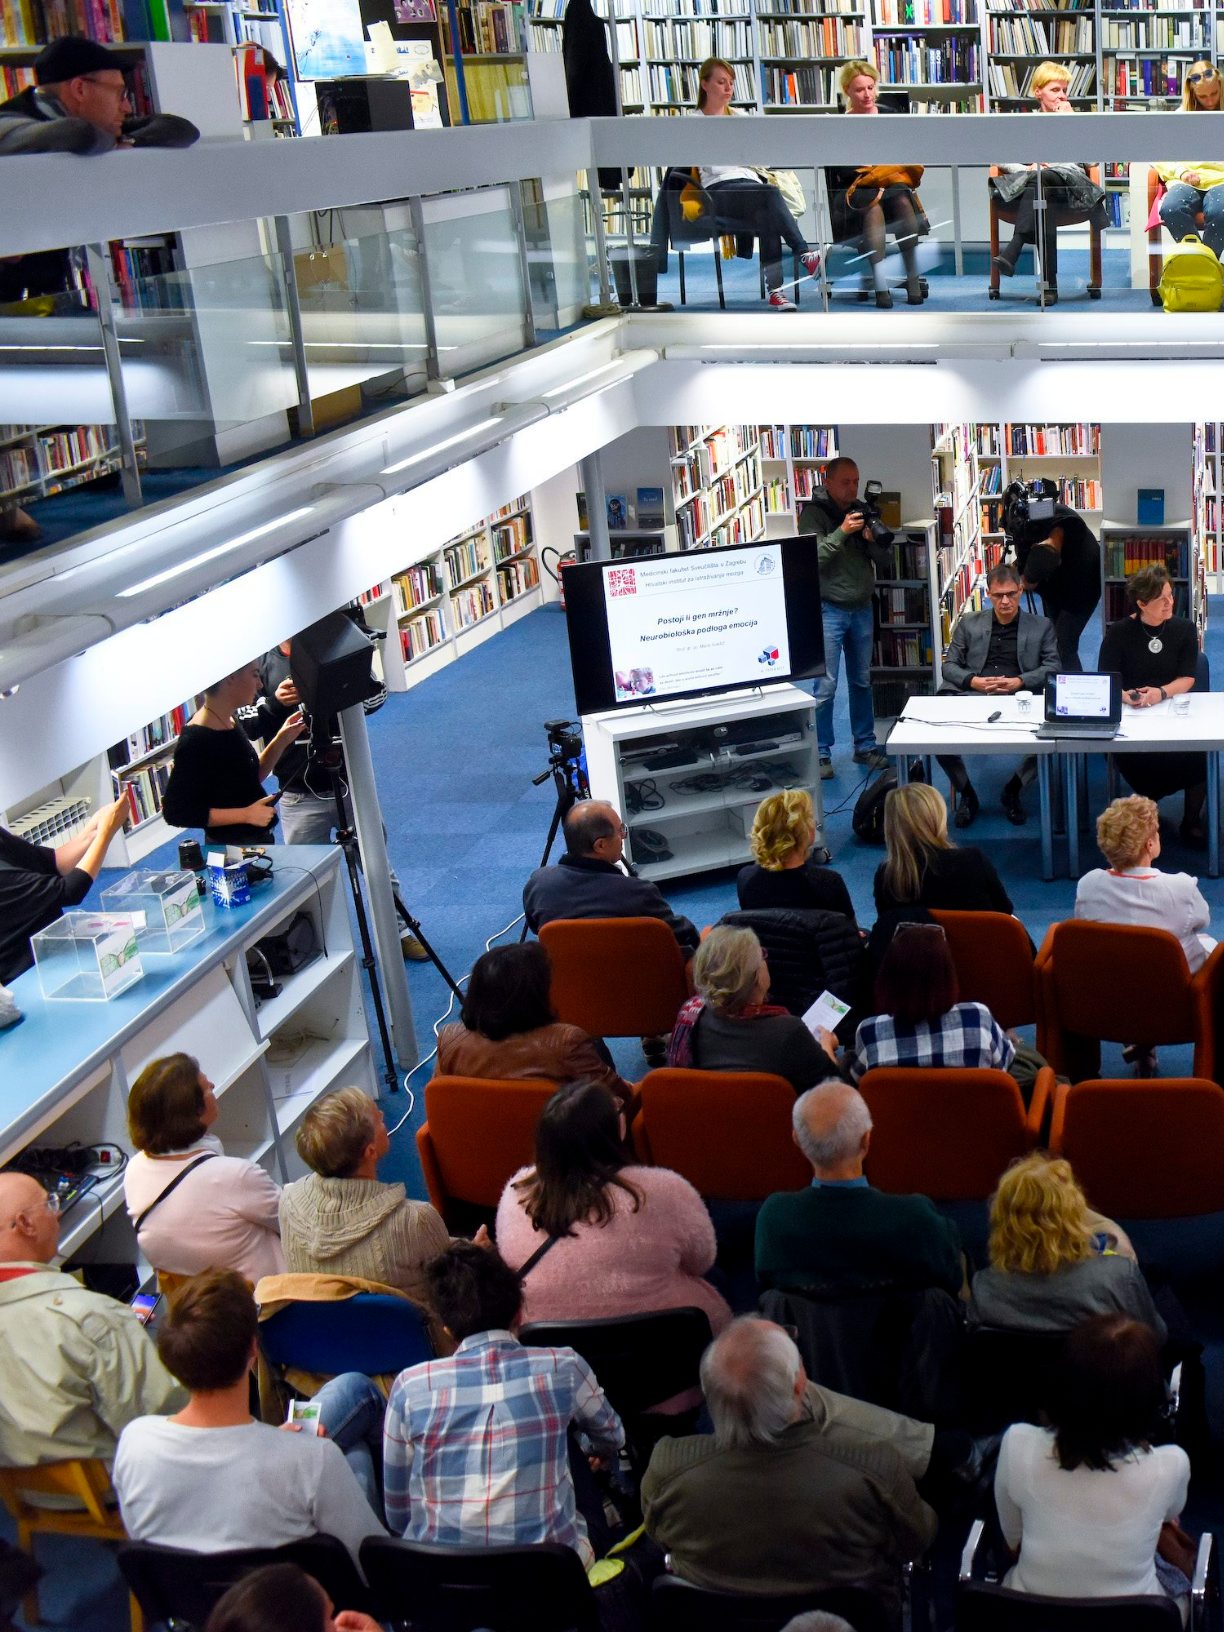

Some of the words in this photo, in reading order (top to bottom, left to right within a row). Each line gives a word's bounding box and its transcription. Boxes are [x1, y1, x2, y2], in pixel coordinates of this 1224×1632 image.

[657, 613, 685, 625] Postoji
[685, 613, 691, 621] li
[692, 612, 707, 622] gen
[707, 607, 739, 619] mržnje?
[639, 628, 696, 643] Neurobiološka
[696, 624, 728, 636] podloga
[728, 619, 758, 630] emocija
